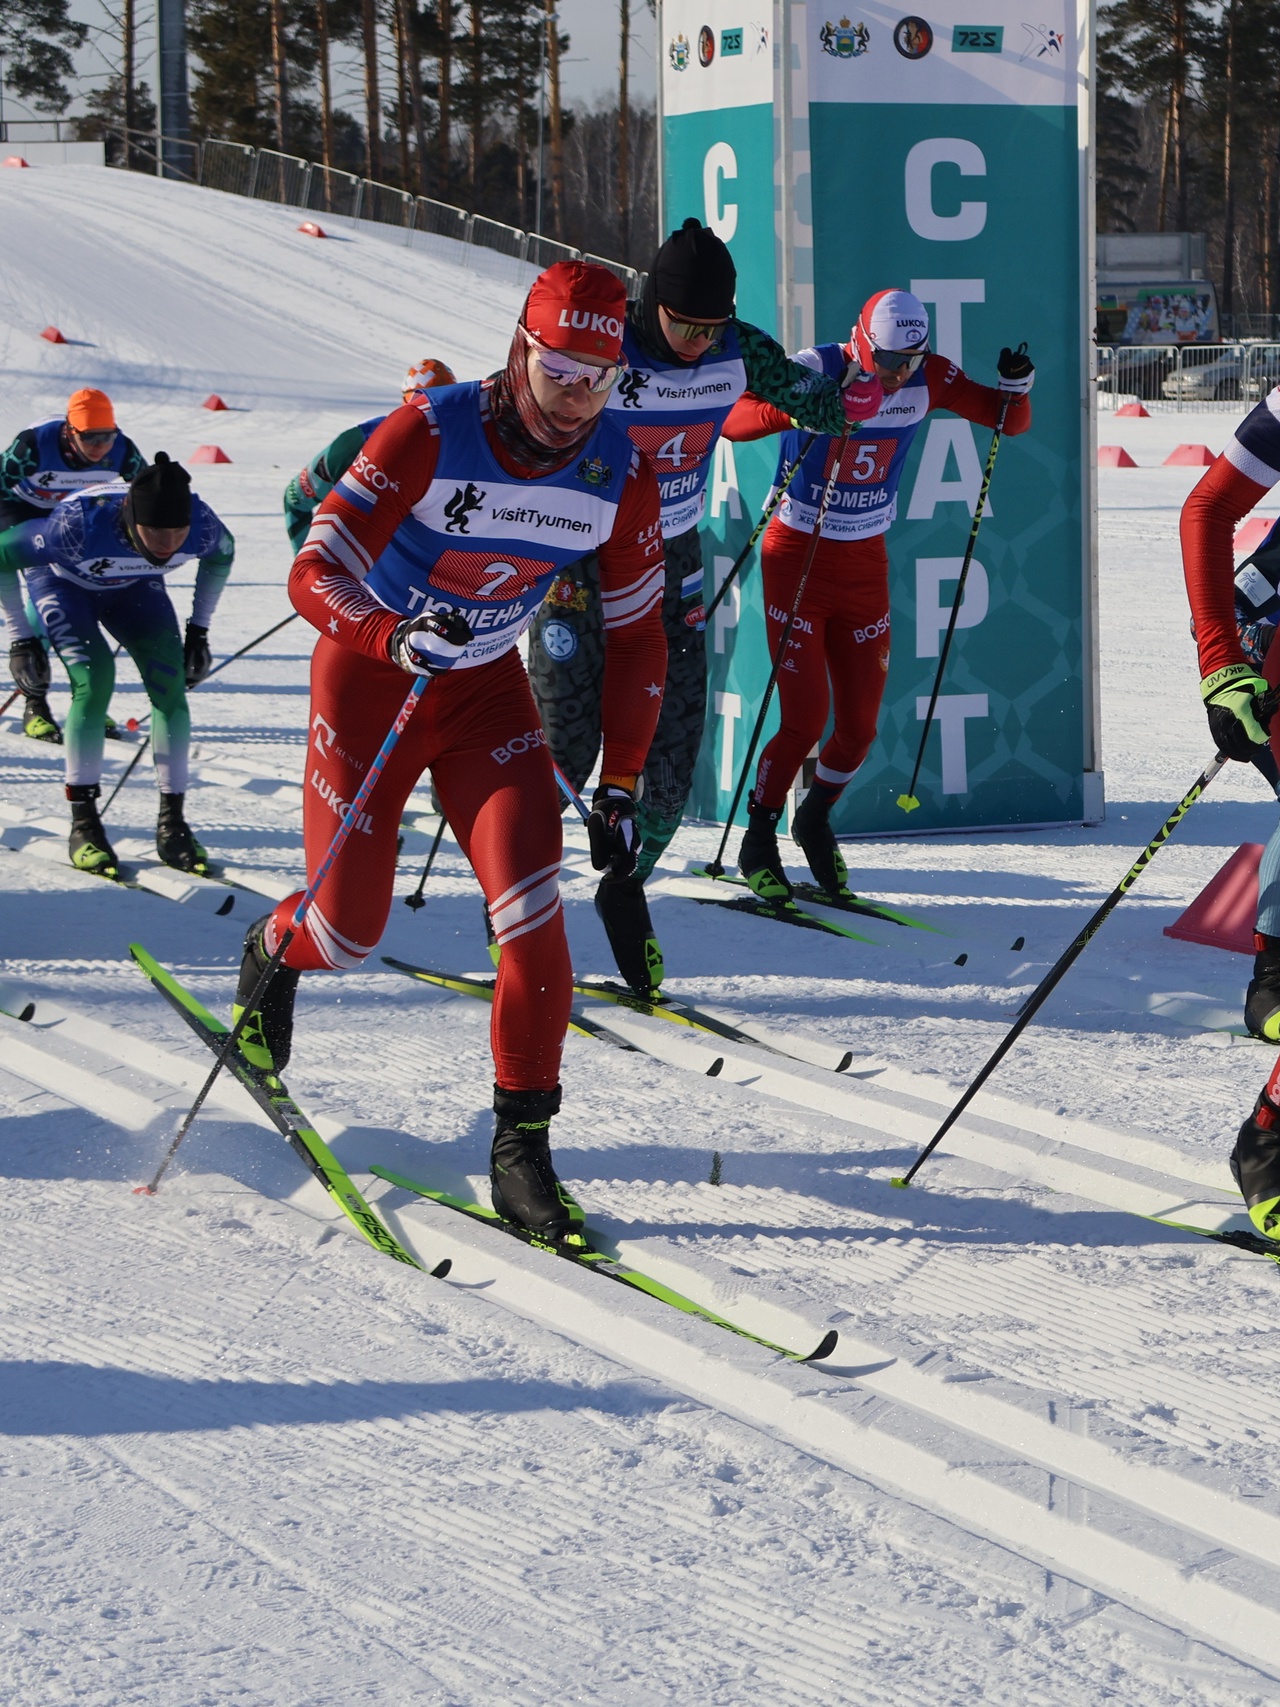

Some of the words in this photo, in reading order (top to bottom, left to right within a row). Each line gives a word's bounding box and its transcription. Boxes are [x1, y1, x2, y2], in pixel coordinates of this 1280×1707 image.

[896, 319, 926, 328] LUKOIL
[656, 382, 731, 399] VisitTyumen
[656, 432, 687, 466] 4
[703, 141, 743, 792] САРТ
[852, 445, 877, 481] 5
[879, 466, 885, 479] 1
[491, 506, 593, 534] VisitTyumen
[813, 893, 832, 903] FISCHER
[757, 907, 776, 916] FISCHER
[530, 1239, 558, 1255] FISCHER
